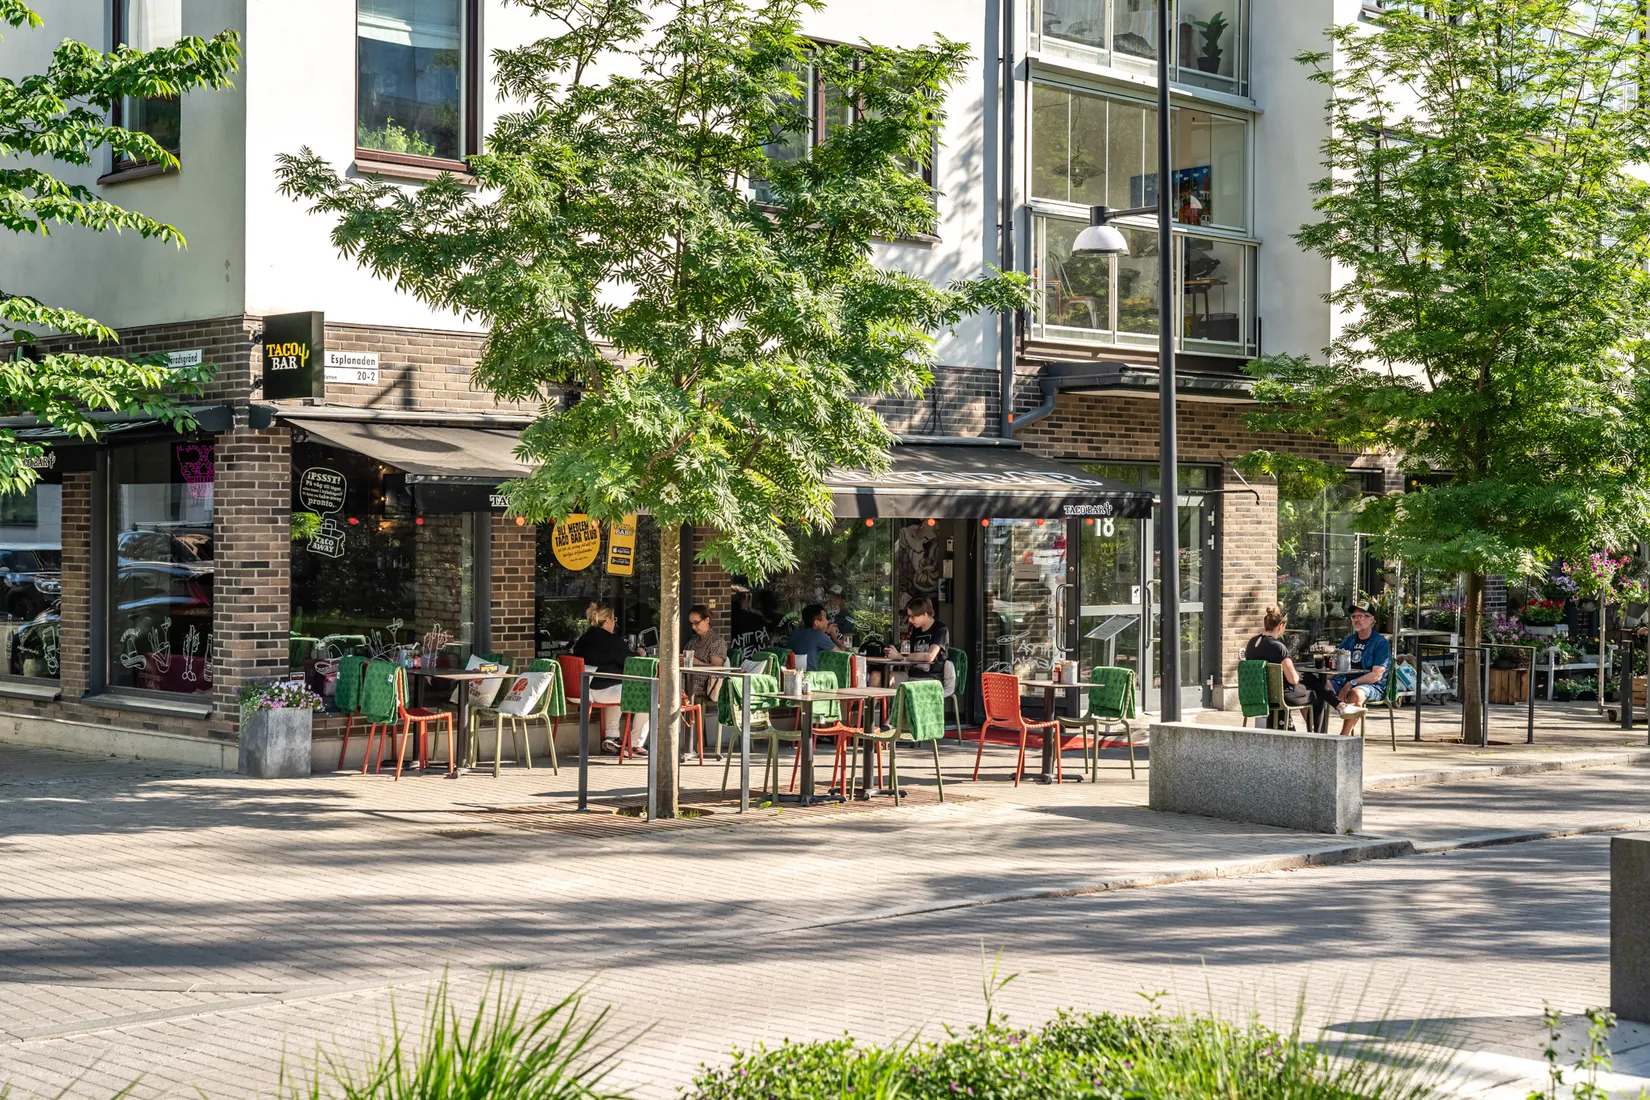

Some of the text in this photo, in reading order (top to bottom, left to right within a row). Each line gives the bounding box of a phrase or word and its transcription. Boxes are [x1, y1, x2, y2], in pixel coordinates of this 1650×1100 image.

[266, 342, 298, 357] TACO
[170, 352, 197, 365] äradsgränd
[271, 356, 298, 371] BAR
[331, 354, 376, 367] Esplanaden
[357, 371, 375, 381] 20-2
[489, 494, 511, 507] TA
[1063, 505, 1106, 515] TACO BAR
[1095, 517, 1115, 537] 18
[555, 535, 569, 547] TACO
[570, 532, 582, 544] BAR
[583, 529, 598, 541] CLUB
[312, 542, 335, 552] AWAY
[755, 626, 770, 643] PÅ
